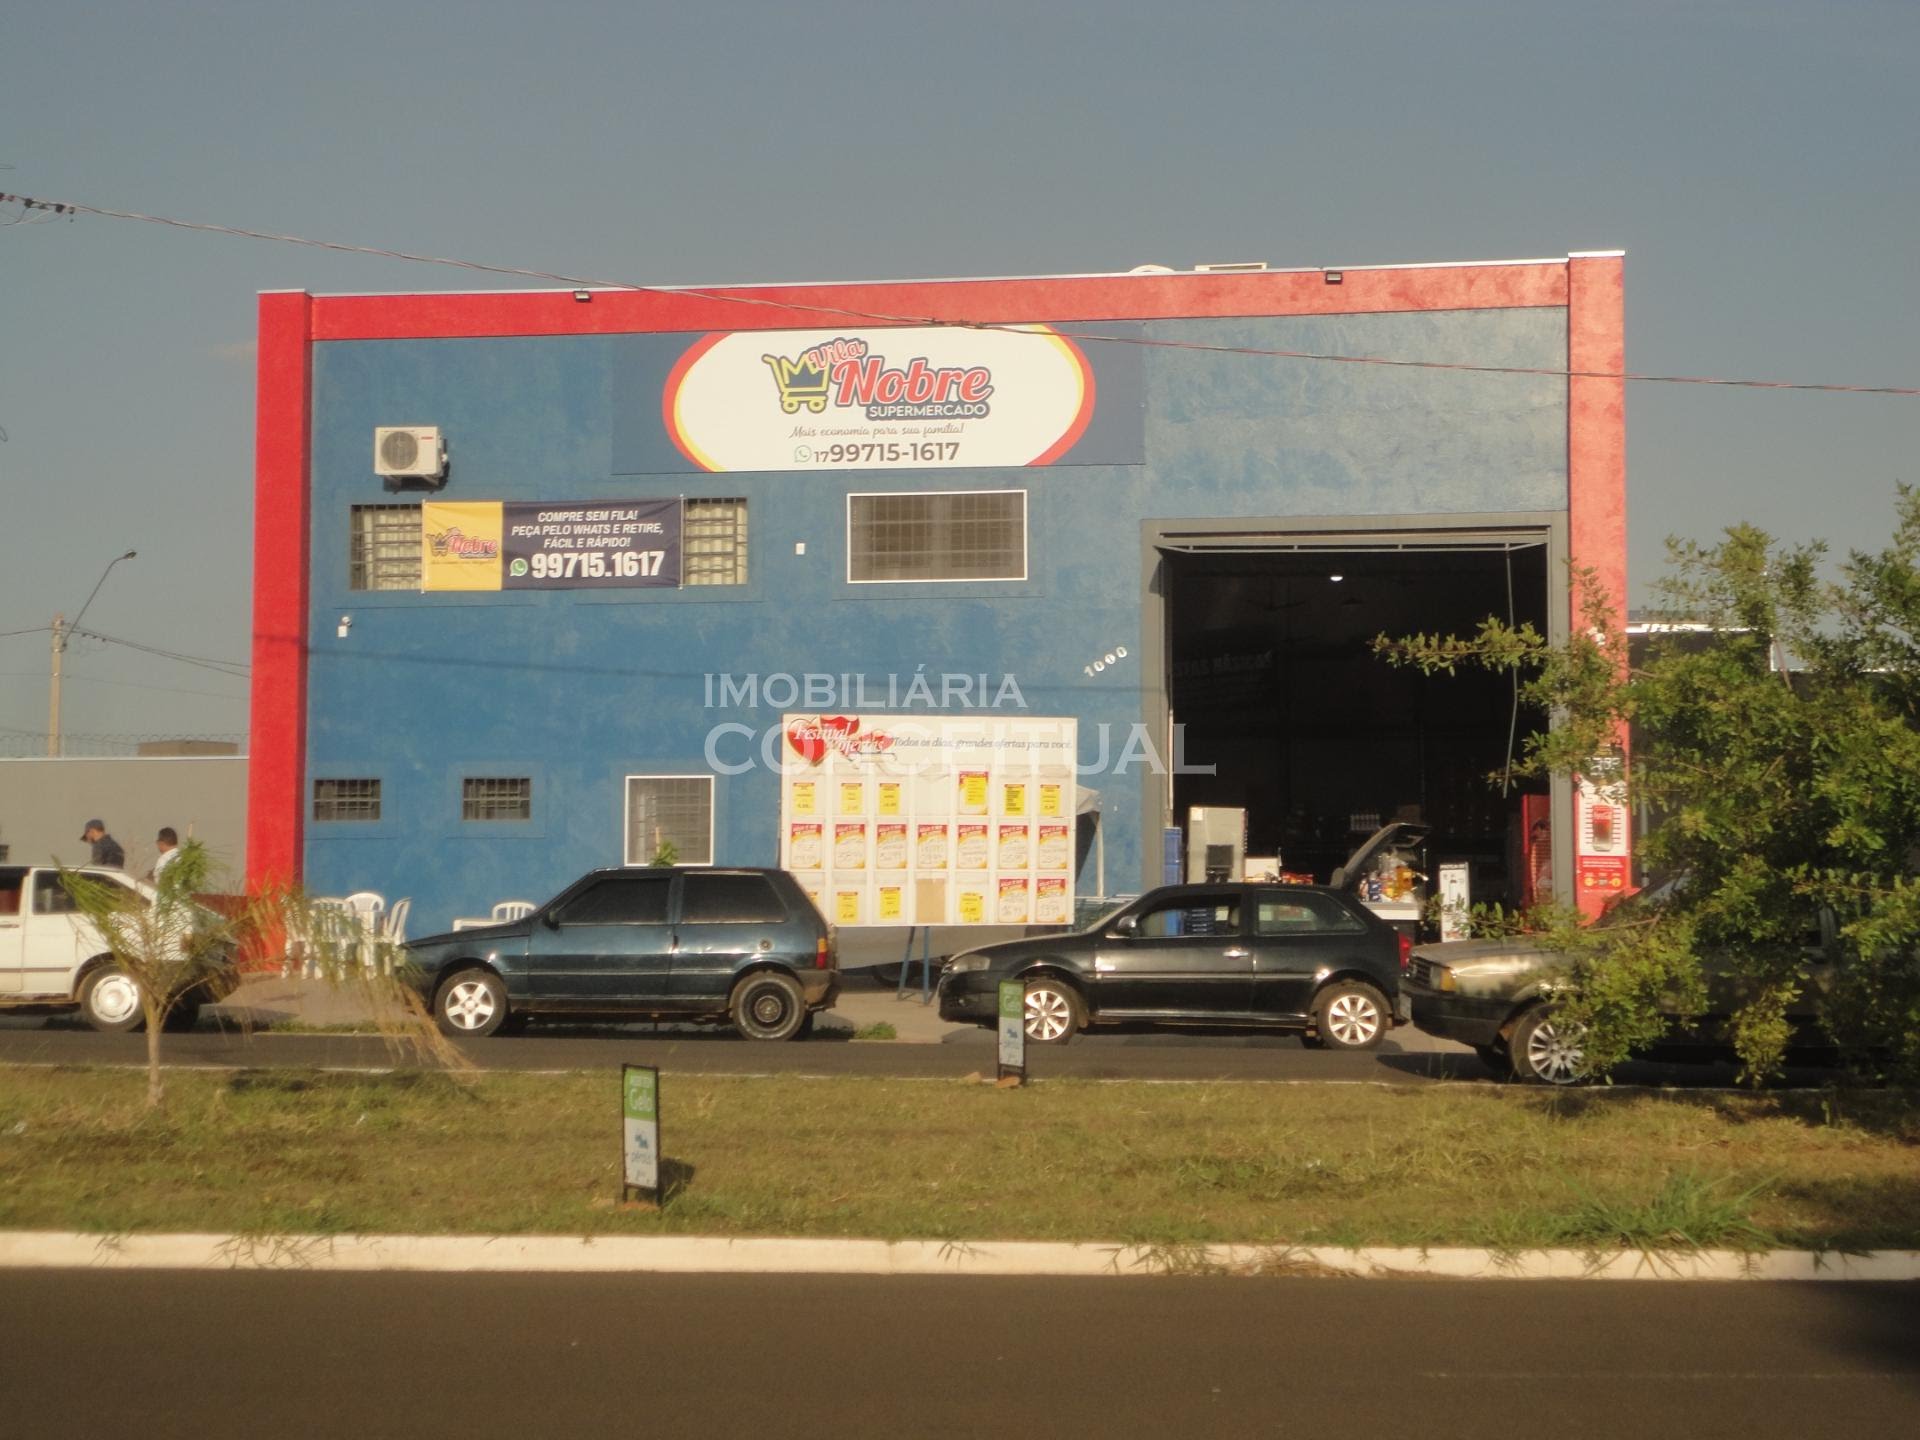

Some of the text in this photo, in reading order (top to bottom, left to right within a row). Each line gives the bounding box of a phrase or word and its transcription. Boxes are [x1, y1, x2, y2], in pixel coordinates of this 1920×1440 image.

[807, 339, 867, 369] Vila
[833, 356, 993, 405] Nobre
[868, 403, 987, 418] SUPERMERCADO
[788, 426, 817, 439] Mais
[820, 427, 870, 437] economia
[872, 427, 898, 439] para
[902, 427, 920, 436] sua
[537, 510, 639, 523] COMPRE SEM FILA!
[511, 522, 664, 539] PEÇA PELO WHATS E RETIRE,
[543, 536, 632, 549] FÁCIL E RÁPIDO!
[531, 551, 665, 579] 99715.1617
[793, 721, 851, 741] Festival
[894, 737, 919, 748] Todos
